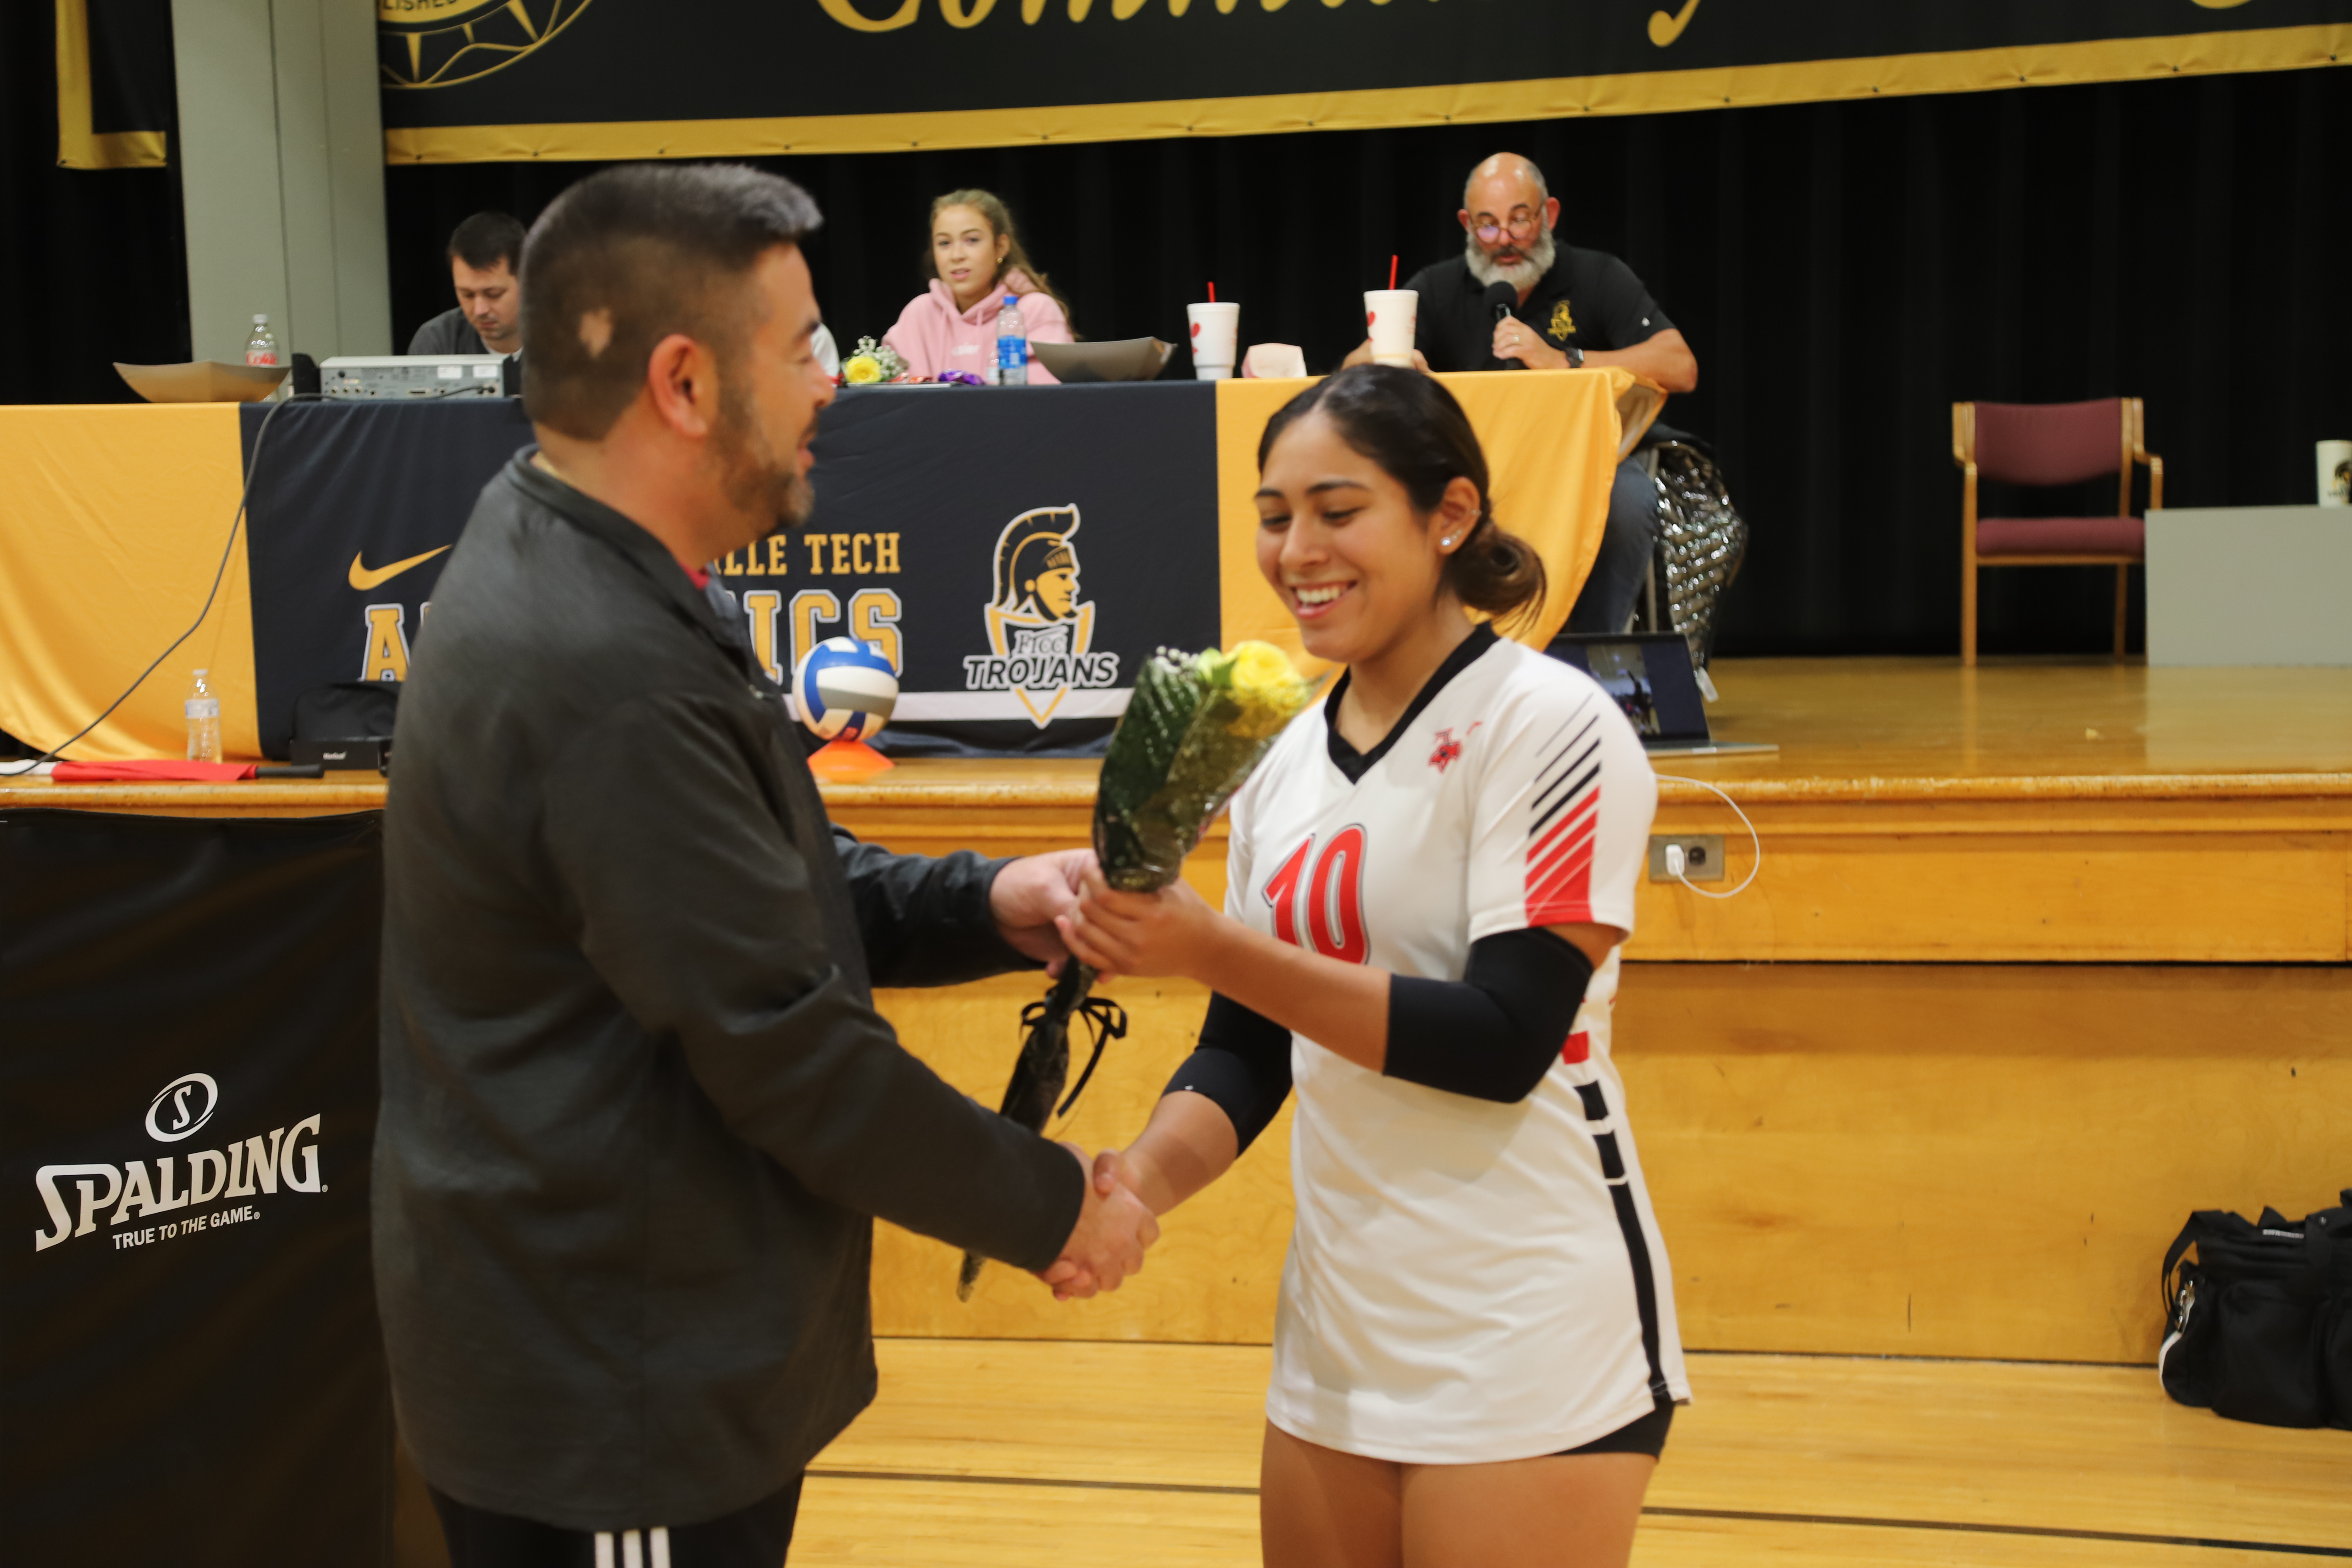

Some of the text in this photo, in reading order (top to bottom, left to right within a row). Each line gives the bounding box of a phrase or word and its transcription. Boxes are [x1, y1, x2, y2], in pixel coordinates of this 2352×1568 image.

[804, 533, 901, 574] TECH
[965, 655, 1116, 686] TROJANS
[1261, 822, 1371, 966] 10
[112, 1228, 155, 1250] TRUE
[159, 1223, 177, 1240] TO
[181, 1215, 207, 1235] THE
